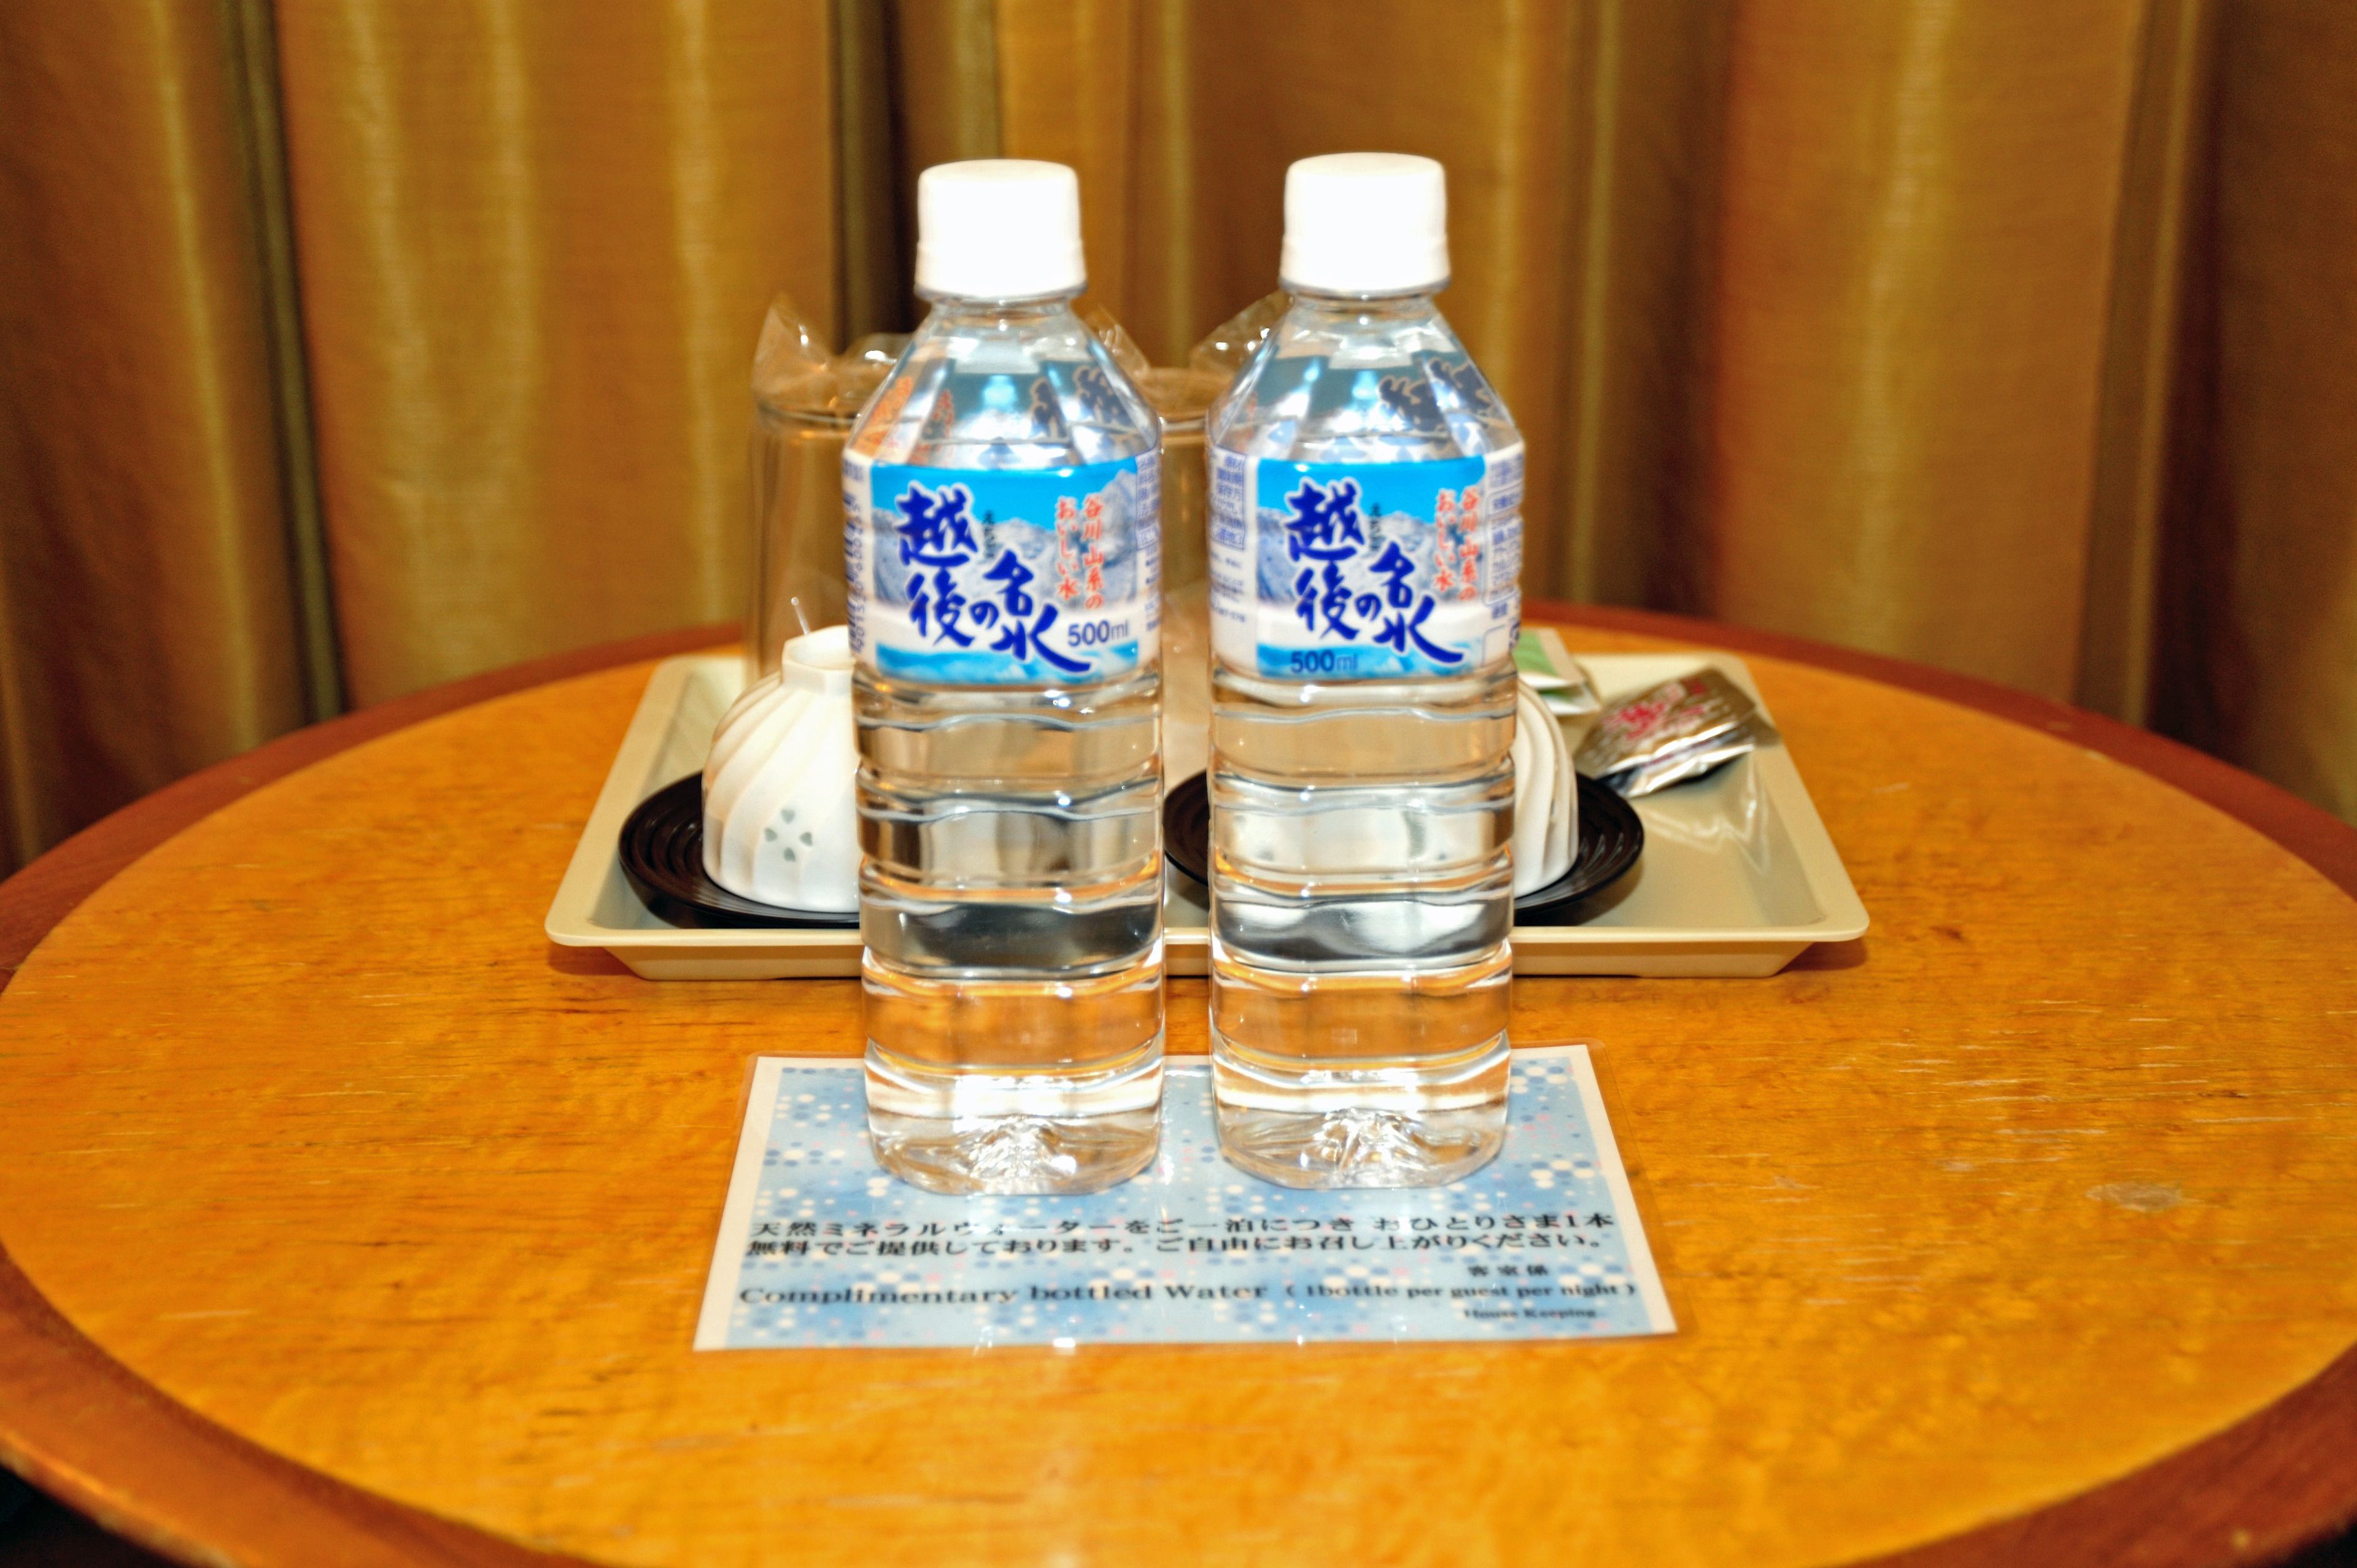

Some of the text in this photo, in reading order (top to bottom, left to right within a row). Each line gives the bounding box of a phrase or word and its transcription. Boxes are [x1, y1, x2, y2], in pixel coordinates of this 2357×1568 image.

[1057, 498, 1078, 600] おいしい水
[1082, 494, 1104, 610] 谷川山系の
[1434, 492, 1455, 593] おいしい水
[1067, 620, 1129, 647] 500ml
[1290, 651, 1358, 673] 500ml
[740, 1286, 1018, 1305] Complimentary
[1030, 1285, 1152, 1300] bottled
[1164, 1284, 1268, 1300] Water
[1407, 1286, 1443, 1300] per
[1450, 1285, 1509, 1299] guest
[1517, 1286, 1553, 1299] per
